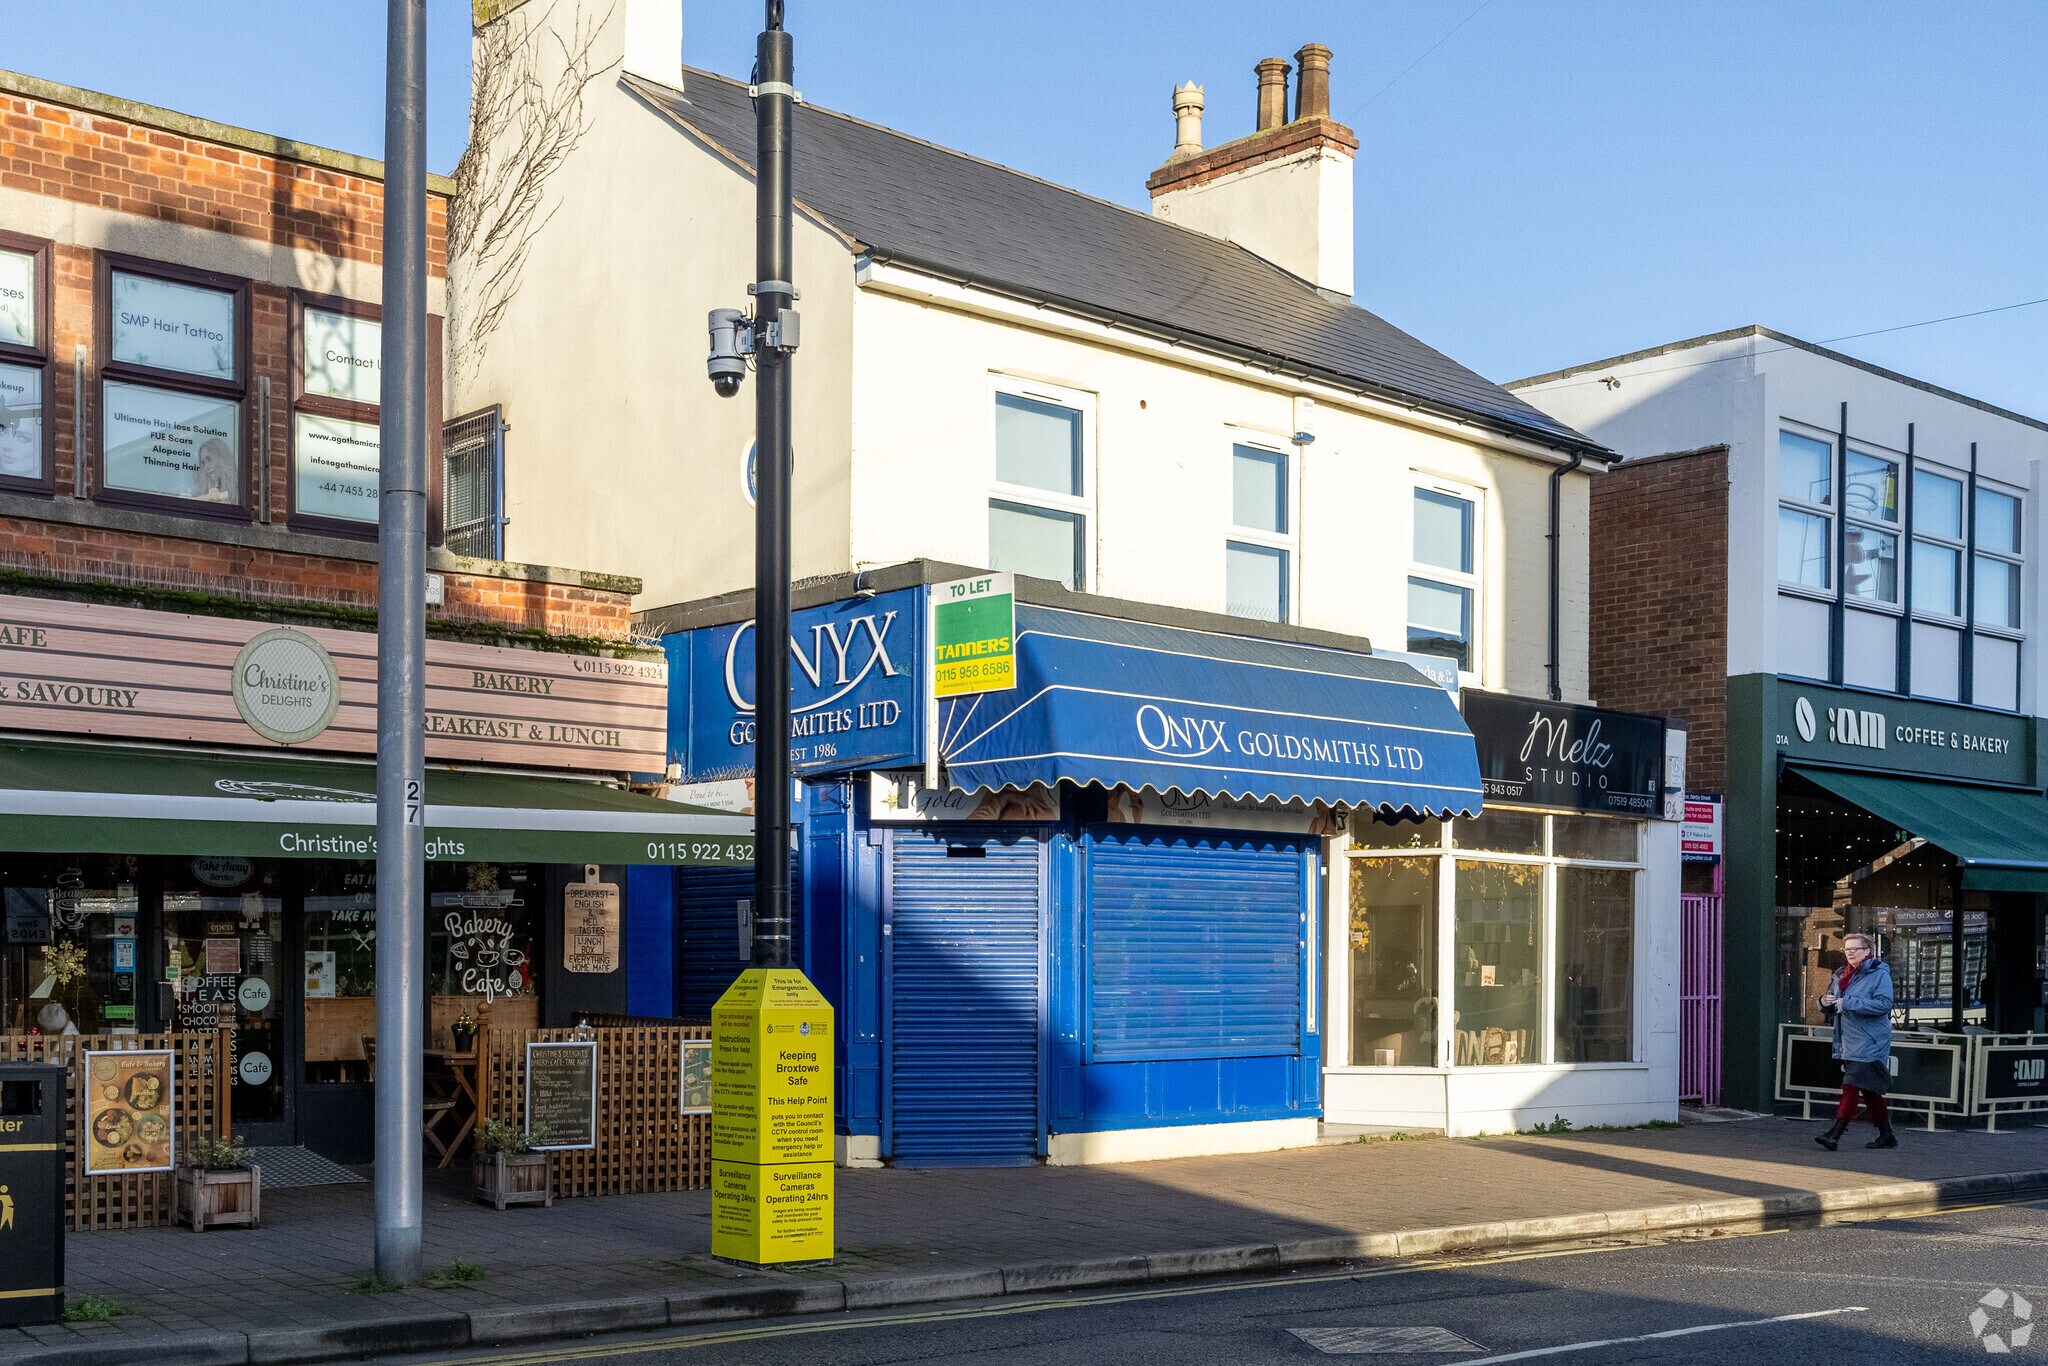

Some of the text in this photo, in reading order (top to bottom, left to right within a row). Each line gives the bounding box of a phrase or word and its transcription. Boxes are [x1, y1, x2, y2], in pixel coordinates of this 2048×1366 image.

[120, 312, 224, 342] SMP Hair Tattoo
[326, 350, 374, 369] Contact
[114, 412, 151, 426] Ultimate
[153, 419, 172, 429] Hair
[193, 425, 228, 438] Solution
[150, 432, 193, 445] FUE Scars
[308, 432, 380, 449] www.agathamicro
[152, 445, 191, 458] Alopecia
[143, 456, 200, 472] Thinning Hair
[319, 482, 379, 498] +44 7453 28
[950, 579, 992, 598] TO LET
[0, 625, 47, 647] AFÉ
[584, 660, 663, 679] 0115 922 4324
[936, 661, 1010, 682] 0115 958 6586
[244, 663, 328, 693] Christine's
[1438, 671, 1445, 682] &
[472, 672, 555, 695] BAKERY
[17, 681, 139, 708] SAVOURY
[261, 694, 312, 708] DELIGHTS
[730, 700, 901, 746] GOMITHS LTD
[425, 715, 621, 747] REAKFAST & LUNCH
[1136, 705, 1423, 771] ONYX GOLDSMITHS LTD
[1520, 711, 1614, 769] Melz
[1895, 725, 1945, 747] COFFEE
[1951, 732, 1958, 748] &
[1963, 734, 2009, 754] BAKERY
[813, 743, 837, 759] 1986
[888, 774, 950, 786] WE BY
[1525, 766, 1608, 789] STUDIO
[407, 781, 419, 801] 2
[1490, 784, 1505, 795] 943
[1506, 785, 1523, 796] 0517
[911, 788, 968, 818] Gold
[1608, 796, 1653, 809] 07519 485047
[406, 805, 419, 823] 7
[1161, 809, 1197, 818] GOLDSMITHS
[425, 836, 465, 860] ghts
[647, 842, 754, 860] 0115 922 432
[197, 861, 249, 876] Take Away
[209, 873, 234, 881] Service
[344, 874, 365, 885] EAT
[355, 893, 371, 904] OR
[575, 900, 604, 908] ENGLISH
[332, 910, 360, 921] TAKE
[210, 924, 233, 932] open
[444, 910, 514, 948] Bakery
[579, 927, 606, 935] TASTES
[578, 937, 601, 945] LUNCH
[581, 946, 595, 954] BOX
[569, 955, 610, 964] EVERYTHING
[462, 968, 505, 1004] Cafe
[719, 1035, 751, 1043] Instructions
[740, 1046, 750, 1054] help
[779, 1051, 817, 1062] Keeping
[776, 1064, 819, 1073] Broxtowe
[788, 1076, 808, 1085] Safe
[768, 1096, 827, 1106] This Help Point
[0, 1119, 23, 1132] ter
[719, 1169, 751, 1180] Surveillance
[773, 1172, 822, 1181] Surveillance
[724, 1180, 747, 1191] Cameras
[780, 1183, 815, 1191] Cameras
[714, 1190, 756, 1203] Operating 24hrs
[766, 1193, 829, 1205] Operating 24hrs
